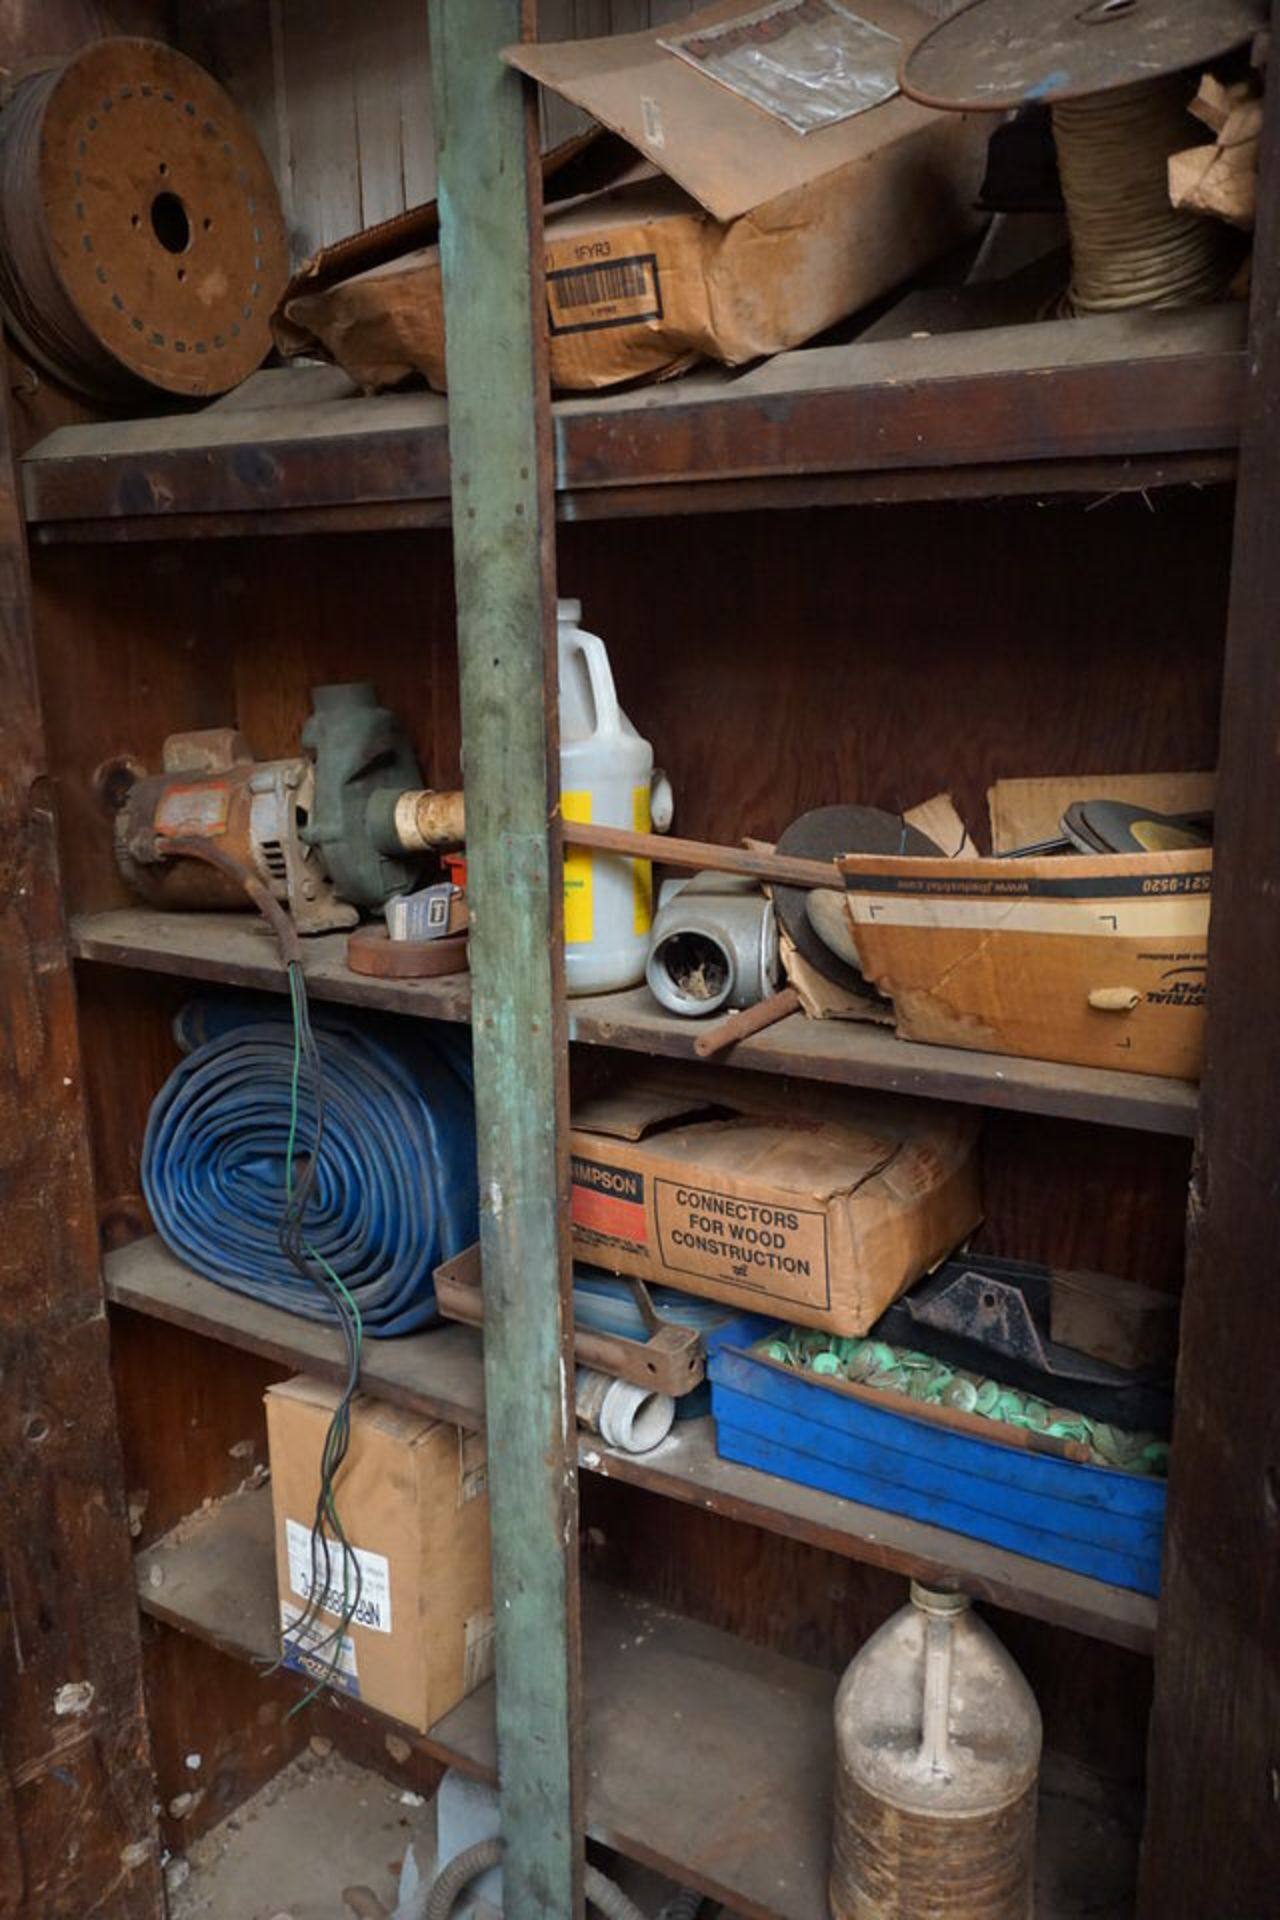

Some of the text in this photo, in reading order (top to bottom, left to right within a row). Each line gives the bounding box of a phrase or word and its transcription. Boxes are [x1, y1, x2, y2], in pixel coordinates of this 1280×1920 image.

[571, 1161, 637, 1195] IMPSON
[676, 1189, 799, 1230] CONNECTORS
[689, 1214, 786, 1249] FOR WOOD
[671, 1229, 811, 1276] CONSTRUCTION
